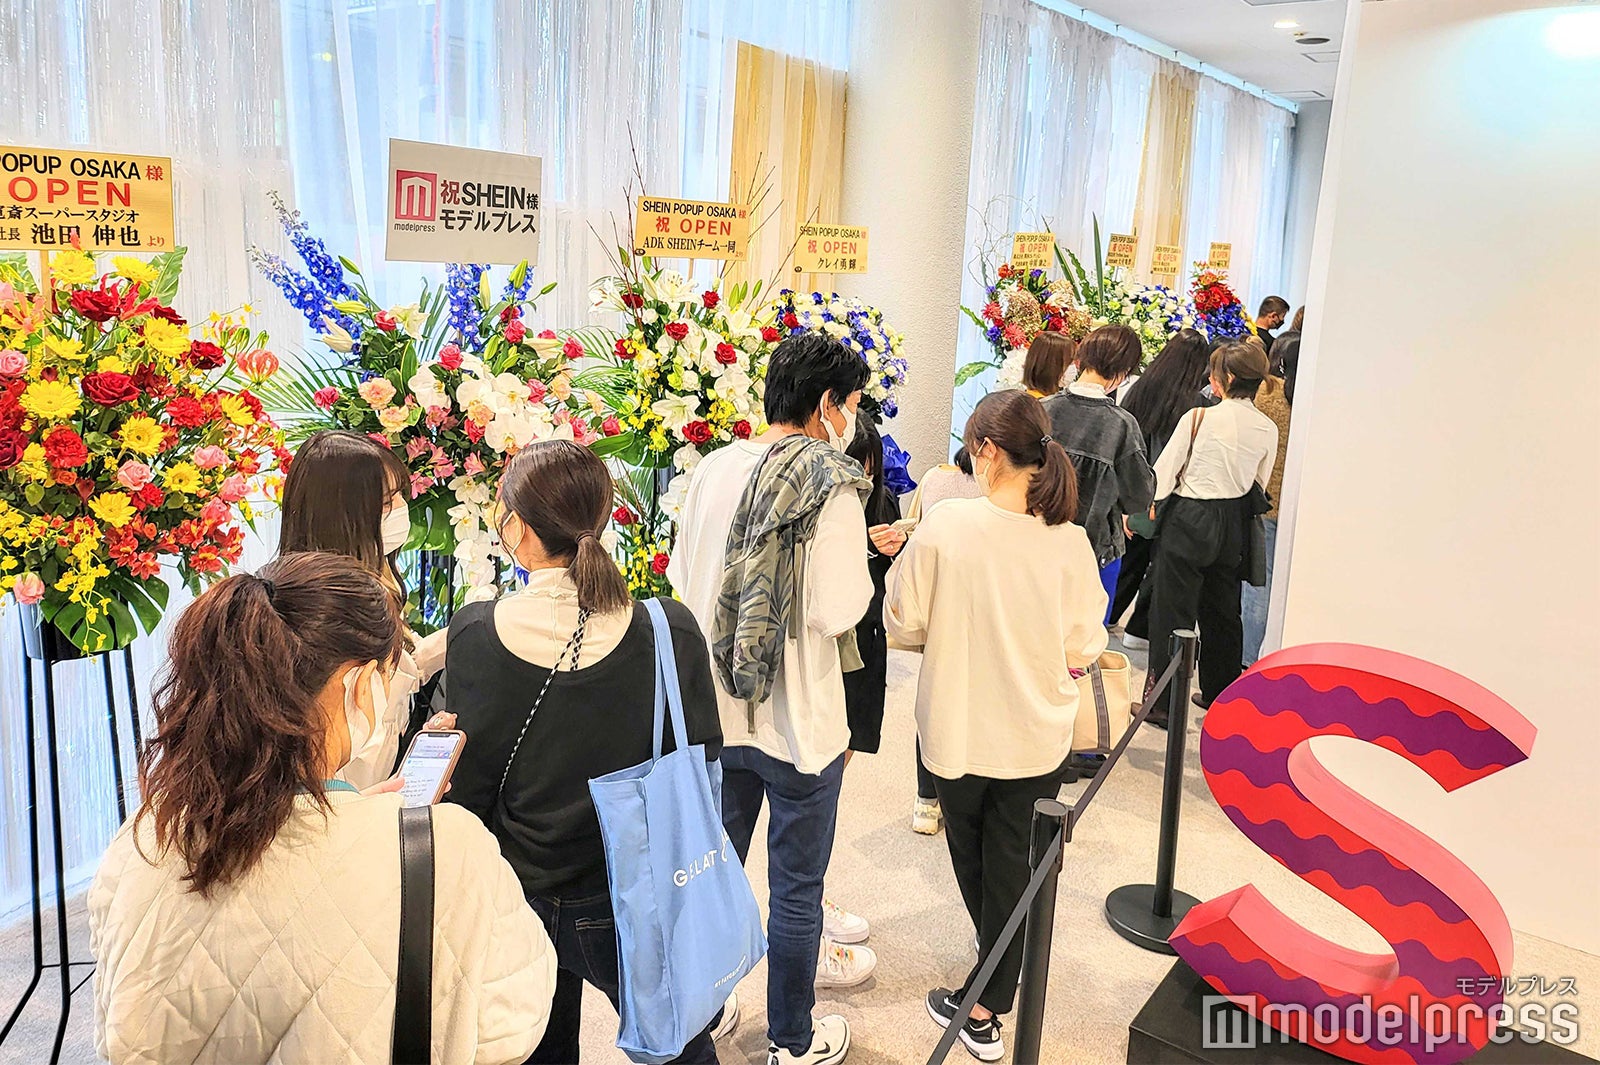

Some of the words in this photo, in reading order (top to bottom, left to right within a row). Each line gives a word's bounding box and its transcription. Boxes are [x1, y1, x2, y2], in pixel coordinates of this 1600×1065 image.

[0, 153, 61, 174] OPUP
[70, 158, 141, 180] OSAKA
[145, 165, 164, 182] 様
[8, 176, 131, 207] OPEN
[643, 200, 671, 214] SHEIN
[673, 203, 704, 216] POPUP
[706, 205, 737, 219] OSAKA
[394, 222, 436, 233] modelpress
[439, 208, 536, 234] モデルプレス
[655, 216, 670, 233] 祝
[680, 218, 731, 236] OPEN
[92, 225, 141, 247] 伸也
[147, 235, 165, 247] より
[643, 236, 665, 249] ADK
[819, 227, 839, 238] POPUP
[840, 228, 860, 239] OSAKA
[823, 240, 857, 255] OPEN
[1027, 243, 1048, 253] OPEN
